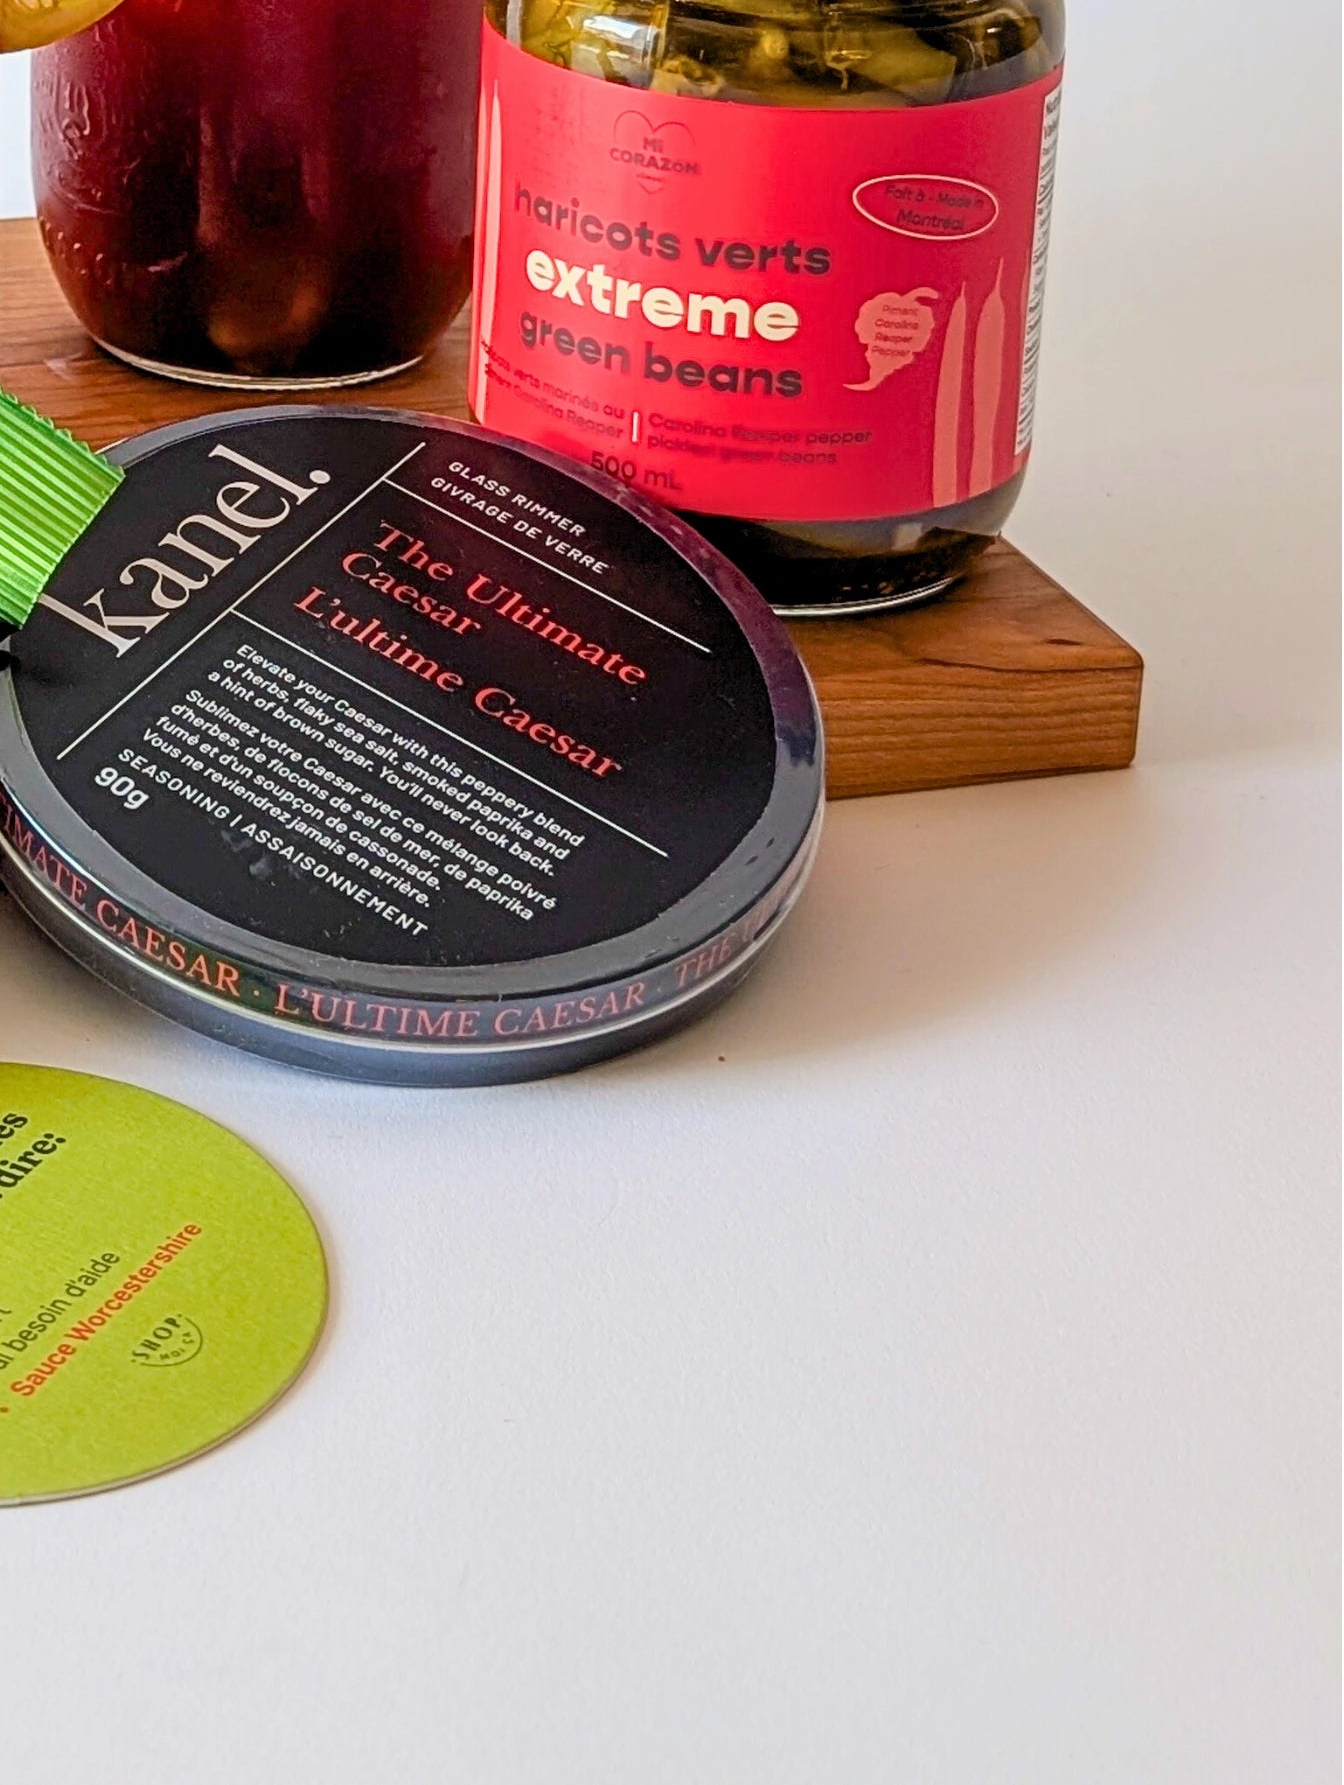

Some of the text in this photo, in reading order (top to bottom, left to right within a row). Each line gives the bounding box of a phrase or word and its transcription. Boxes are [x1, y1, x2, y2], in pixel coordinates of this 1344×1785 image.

[514, 182, 831, 275] haricots verts
[526, 249, 800, 341] extreme
[520, 311, 631, 375] green
[643, 341, 803, 398] beans
[603, 404, 625, 420] au
[449, 461, 587, 537] GLASS RIMMER
[590, 450, 683, 491] 500 mL
[648, 413, 872, 447] Carolina pepper
[341, 552, 482, 636] Caesar
[430, 477, 610, 575] GIVRAGE DE VERRE
[373, 519, 648, 686] The Ultimate
[236, 644, 585, 848] Elevate your Caesar with this peppery blend
[294, 586, 623, 778] L'ultime Caesar
[94, 767, 149, 810] 90g
[143, 728, 430, 908] Vous ne reviendrez jamais en arrière.
[156, 716, 441, 891] fumé et d'un soupçon cassonade.
[171, 703, 534, 921] d'herbes, flocons sel mer, paprika
[185, 689, 556, 910] Sublimez votre Caesar avec mélange poivré
[220, 674, 554, 876] hint brown sugar. You'll never look back.
[242, 667, 570, 861] herbs, flaky sea salt, smoked paprika and
[118, 749, 429, 936] SEASONING ASSAISONNEMENT
[96, 899, 732, 1038] CAESAR L'ULTIME CAESAR THE
[3, 1297, 72, 1353] besoin
[64, 1250, 120, 1299] d'aide
[10, 1221, 203, 1397] Sauce Worcestershire
